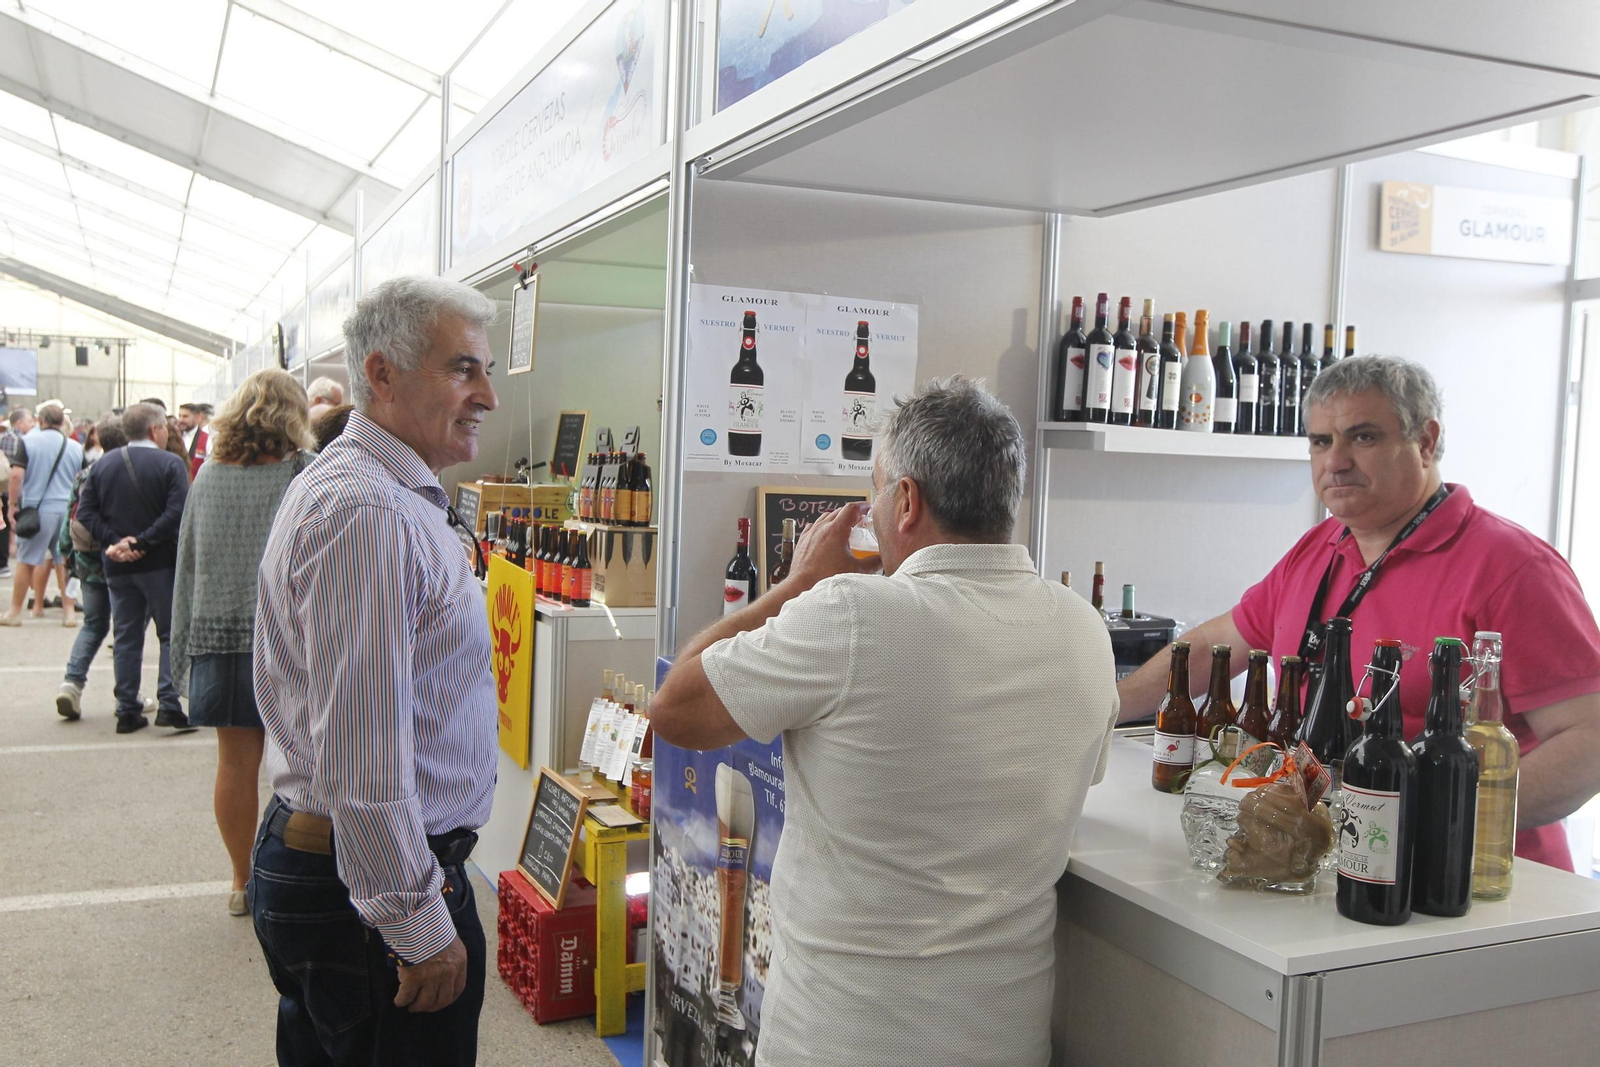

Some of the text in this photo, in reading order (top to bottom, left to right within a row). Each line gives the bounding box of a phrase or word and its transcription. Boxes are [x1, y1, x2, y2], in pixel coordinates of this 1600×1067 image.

[521, 91, 566, 150] CERVEZAS
[1459, 219, 1546, 243] GLAMOUR
[722, 295, 778, 306] GLAMOUR
[837, 305, 890, 317] GLAMOUR
[700, 319, 796, 333] NUESTRO VERMUT
[816, 328, 906, 342] NUESTRO VERMUT
[724, 459, 763, 467] By Moxacar
[838, 463, 846, 471] By
[764, 788, 778, 809] Tlf.
[1345, 793, 1386, 812] Vermut
[1339, 856, 1369, 873] MOUR
